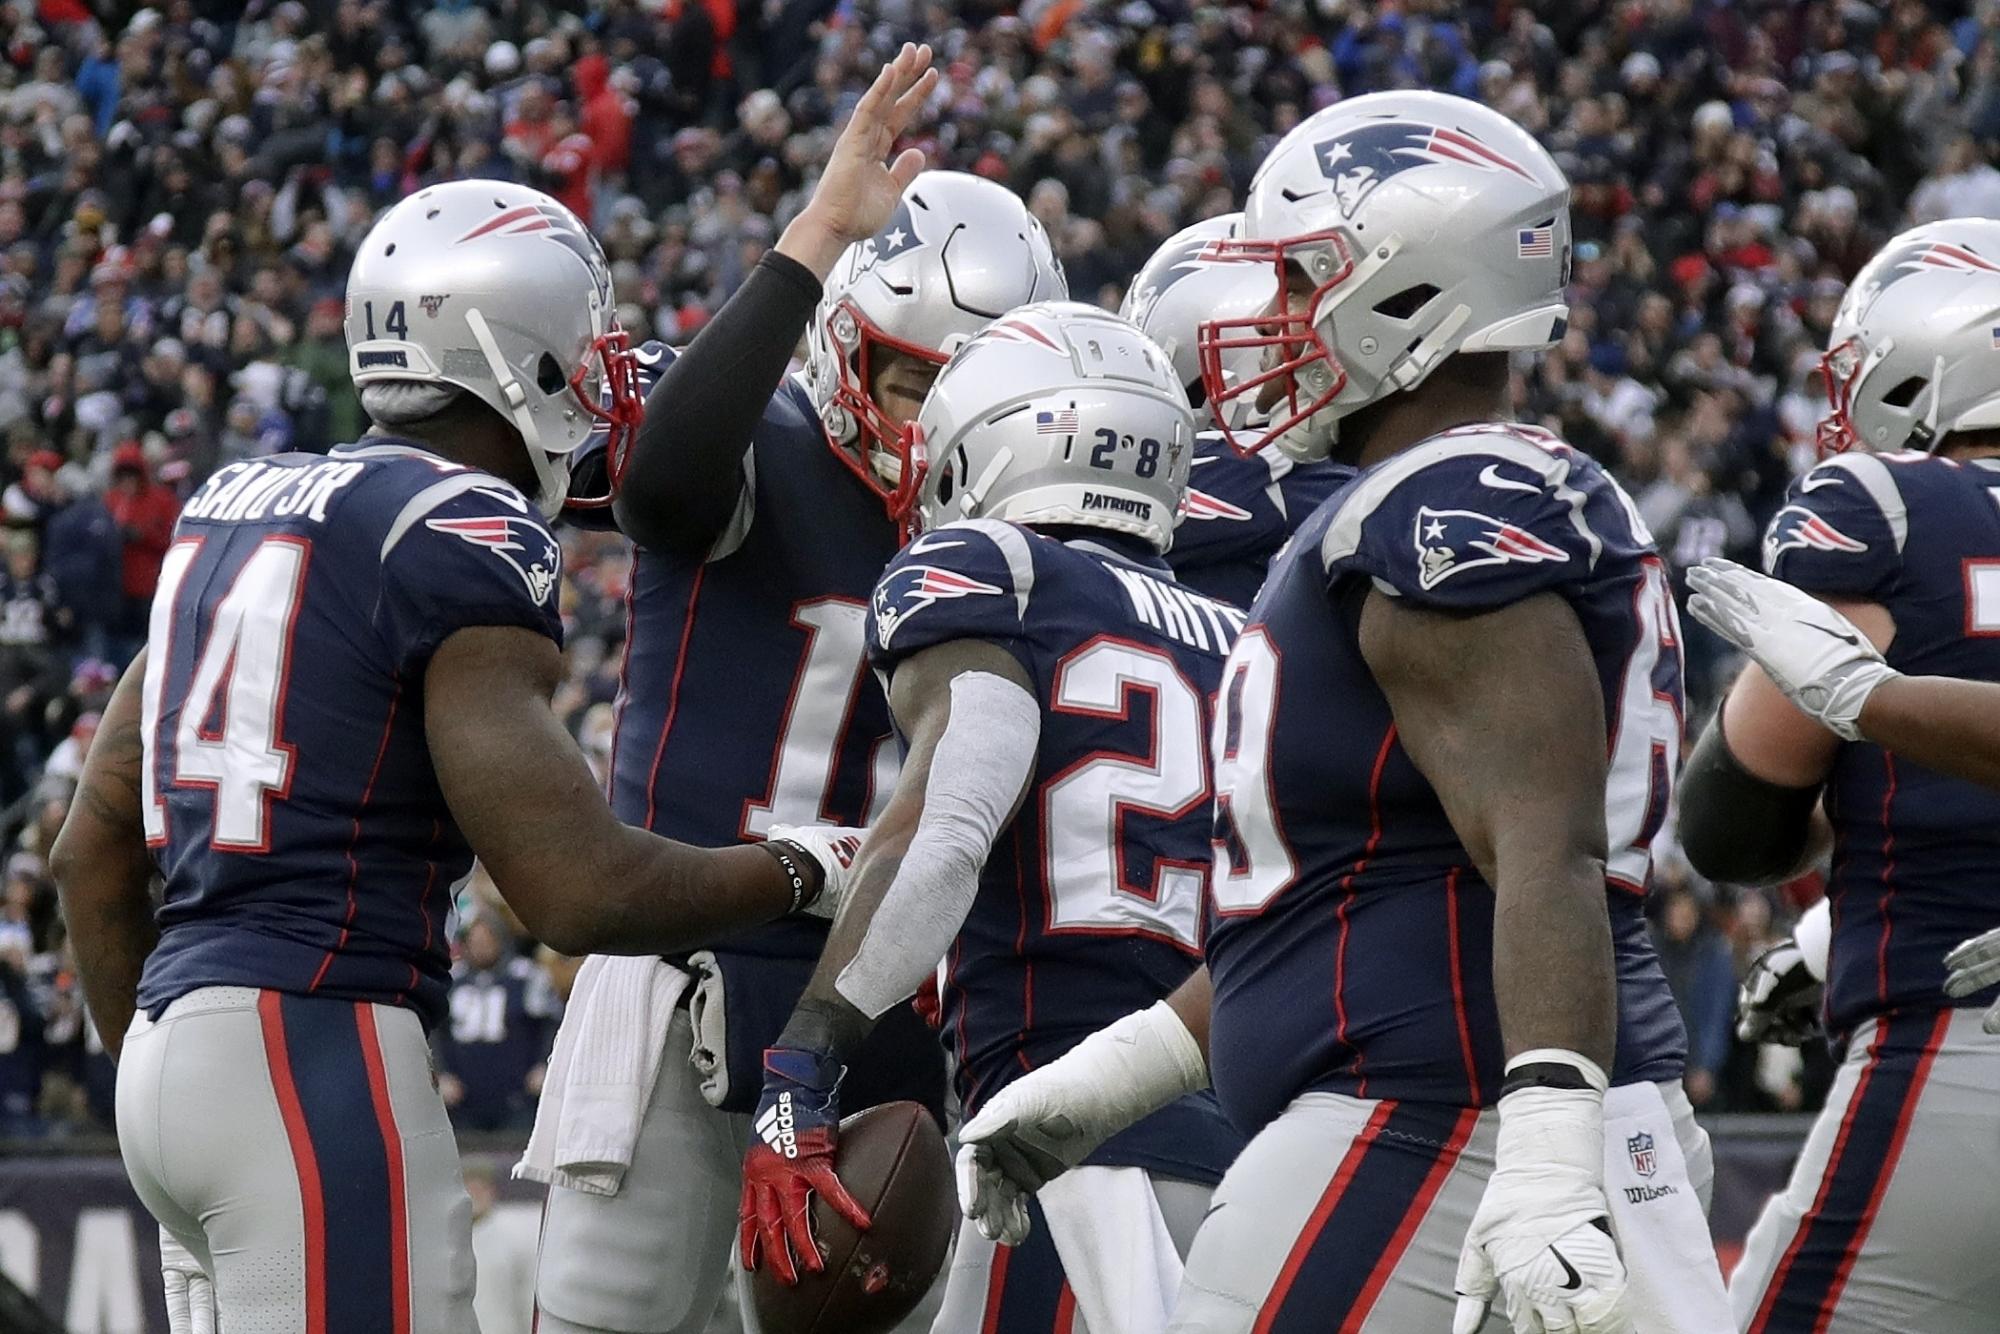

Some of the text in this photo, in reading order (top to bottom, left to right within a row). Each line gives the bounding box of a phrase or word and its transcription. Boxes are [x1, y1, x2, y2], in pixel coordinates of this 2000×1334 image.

[364, 300, 408, 341] 14
[1089, 427, 1161, 479] 28
[1081, 491, 1152, 521] PATRIOTS
[140, 534, 313, 853] 14
[777, 1091, 798, 1159] adidas
[1623, 1185, 1673, 1204] Wilson
